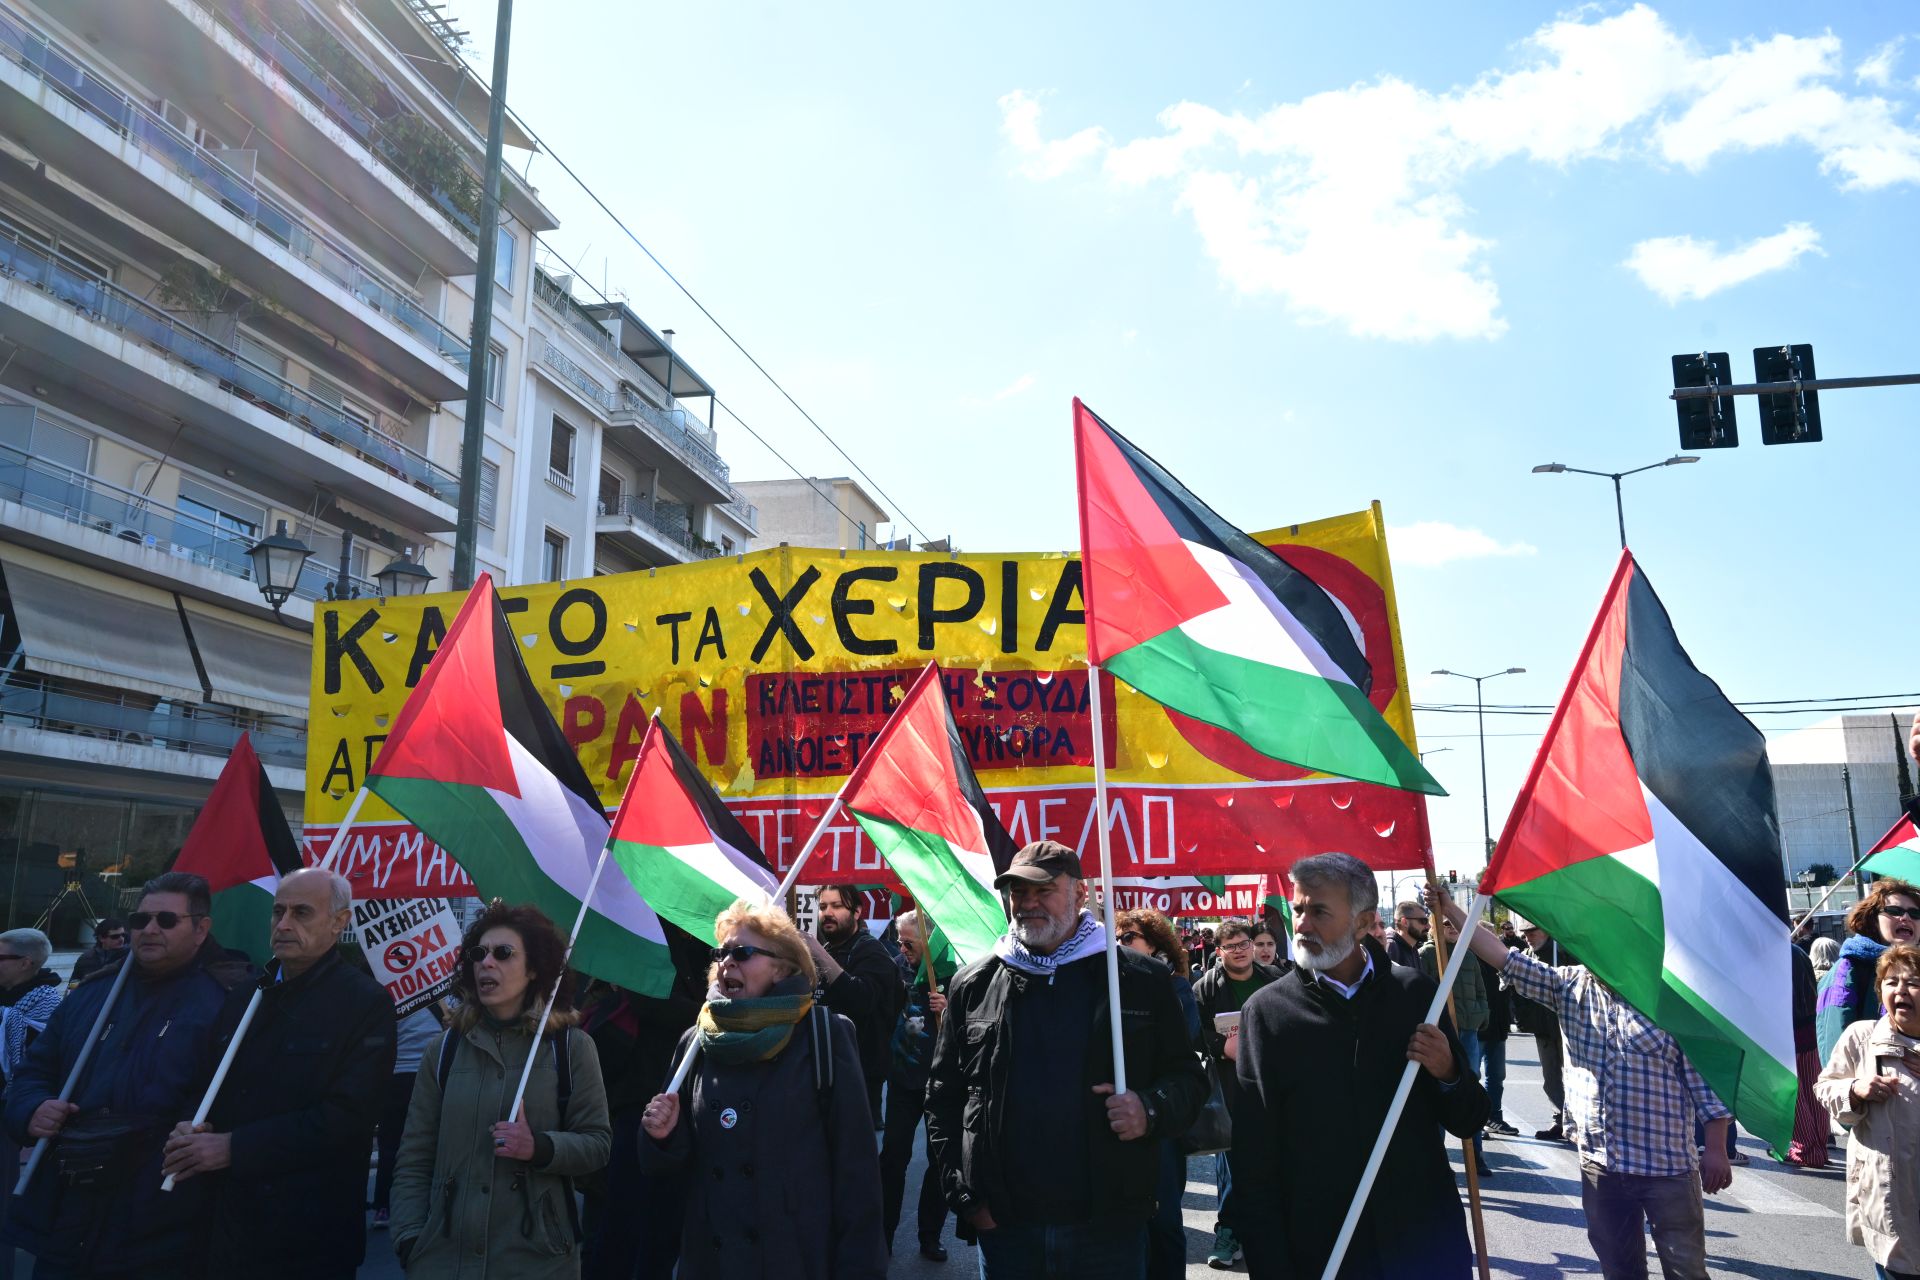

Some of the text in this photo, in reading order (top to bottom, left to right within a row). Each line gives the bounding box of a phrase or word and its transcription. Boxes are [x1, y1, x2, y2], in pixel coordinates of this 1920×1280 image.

[323, 560, 1087, 694] ΚΑΩ ΤΑ ΧΕΡΙΑ
[980, 674, 1092, 714] ΣΟΥΔΑ
[562, 687, 729, 781] ΡΑΝ
[758, 722, 1076, 776] ΑΝΟΙΞΤ ΥΝΟΡΑ
[821, 825, 893, 873] ΤΟ
[990, 795, 1176, 866] ΛΕΜΟ
[364, 897, 447, 950] ΑΥΞΗΣΕΙΣ
